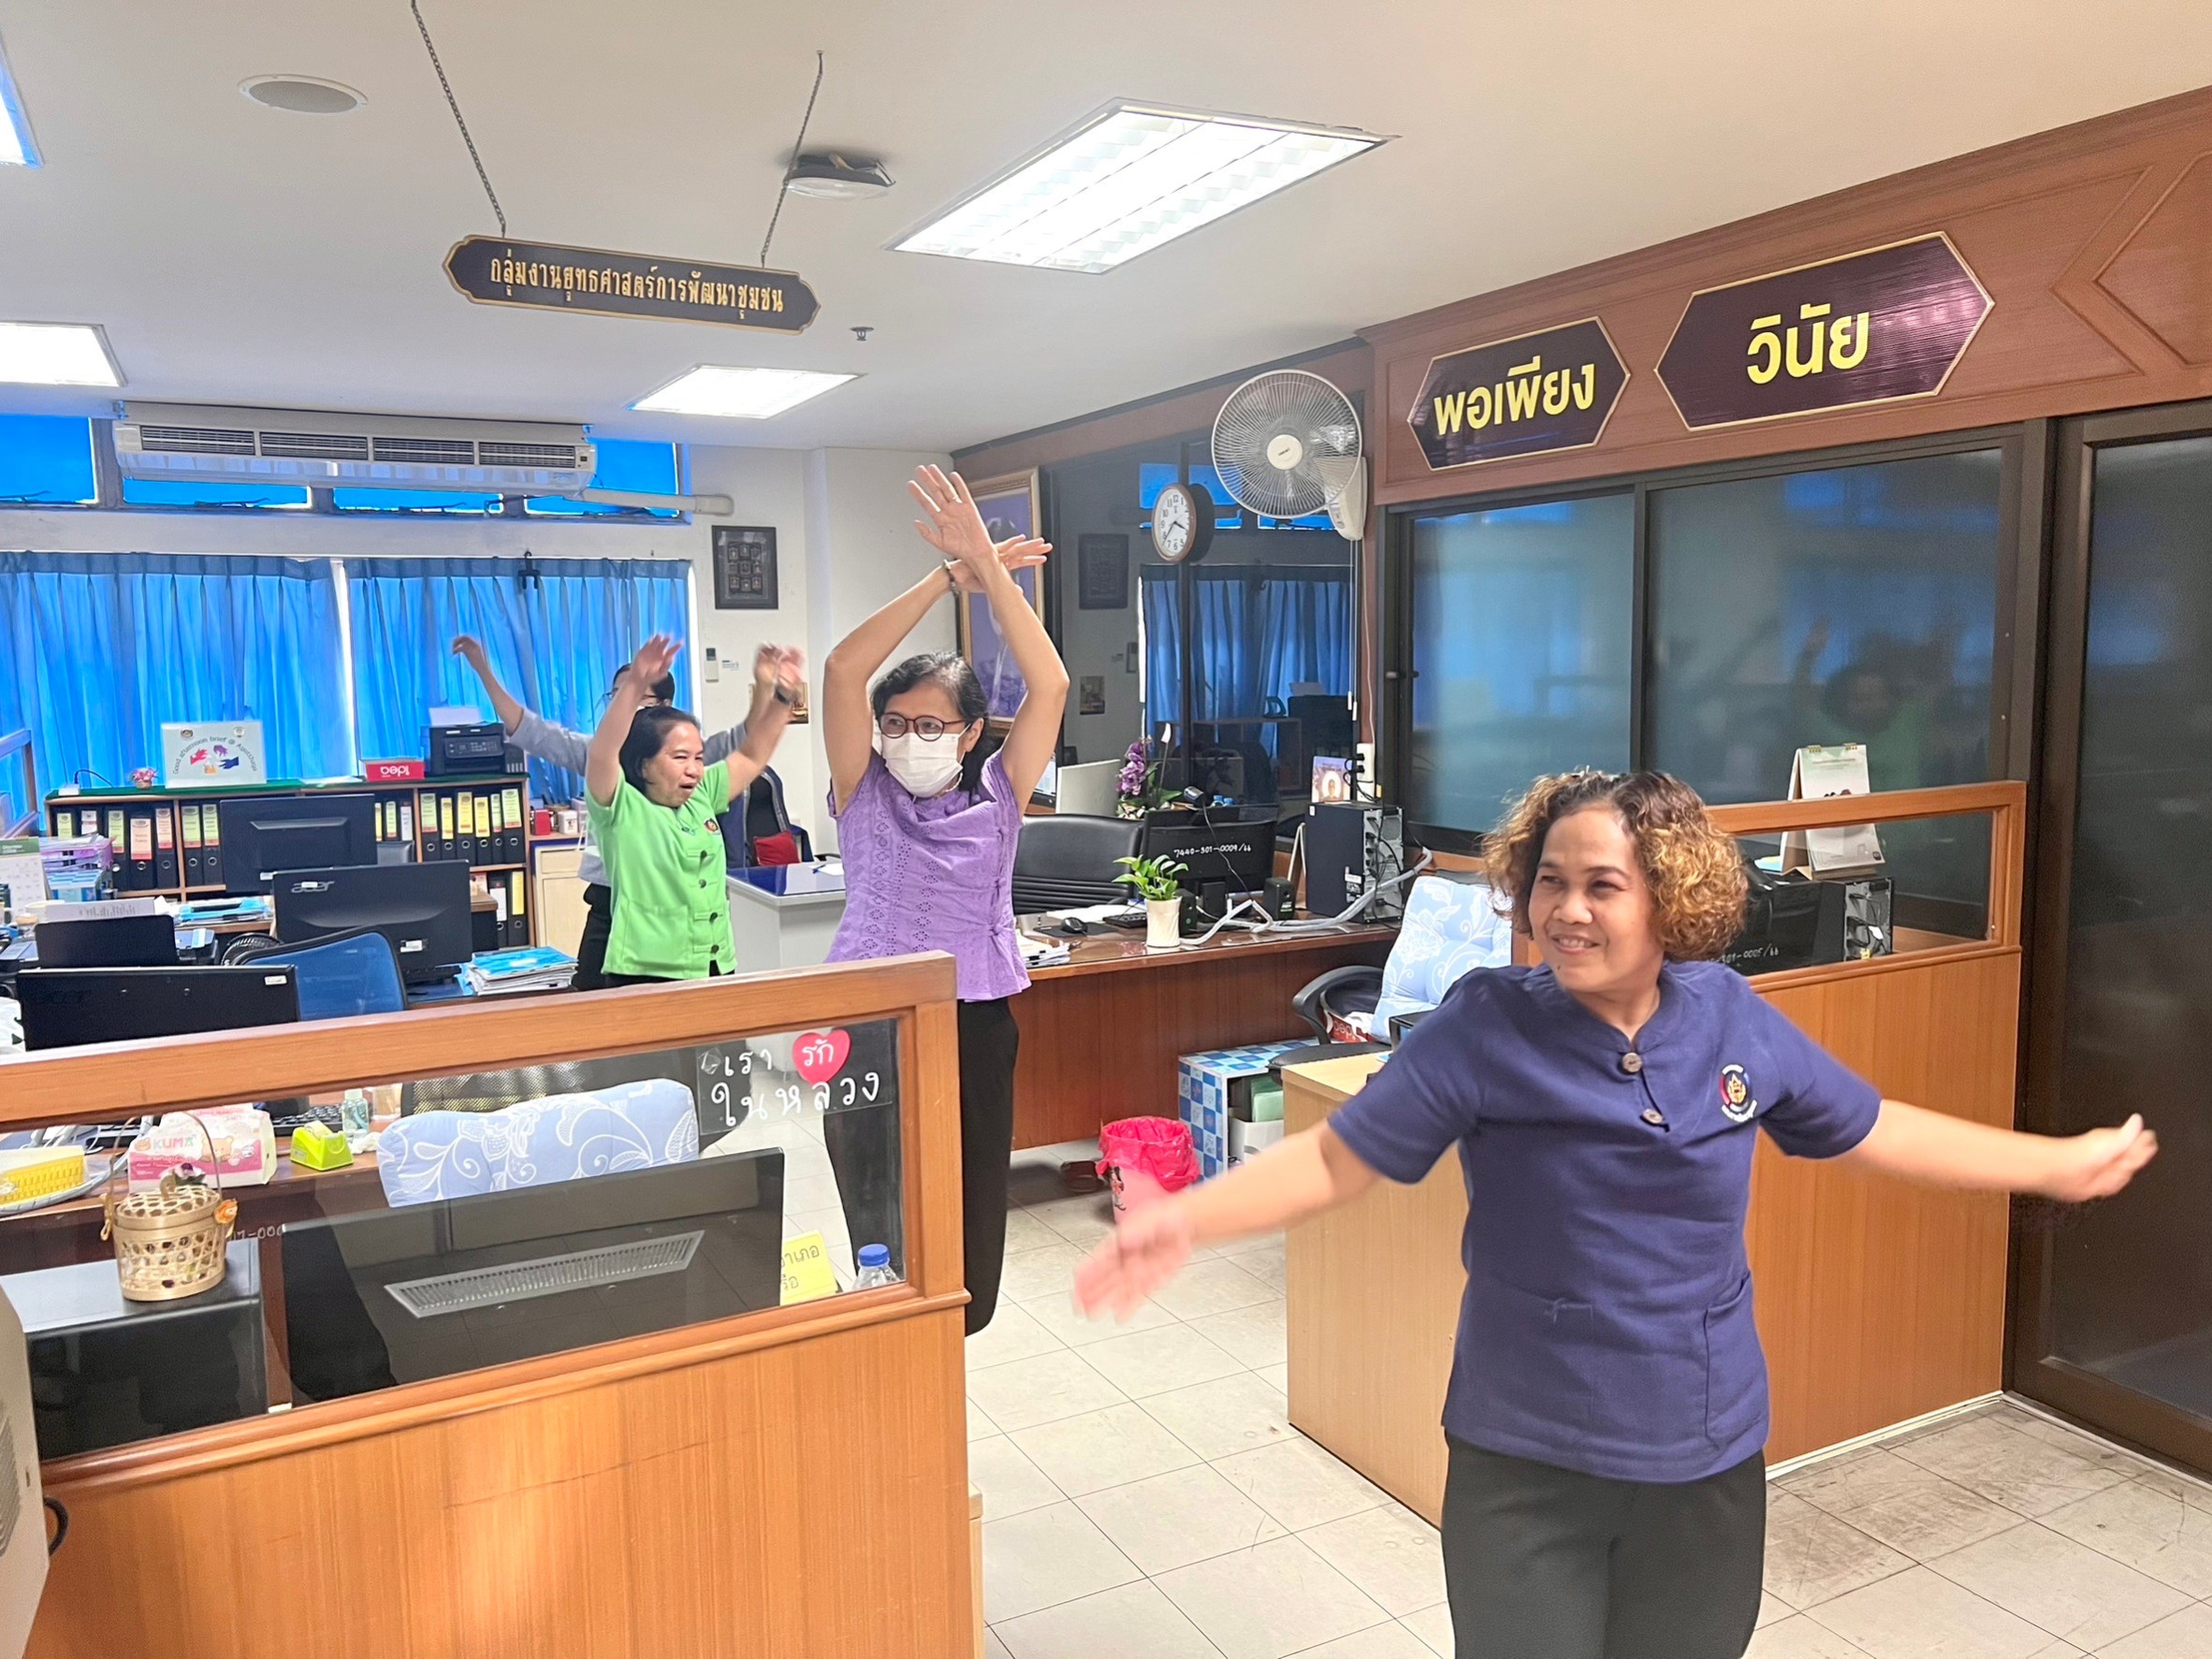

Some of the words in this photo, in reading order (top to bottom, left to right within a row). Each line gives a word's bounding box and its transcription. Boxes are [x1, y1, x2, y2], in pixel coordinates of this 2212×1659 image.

[489, 247, 784, 320] กลุ่มงานยุทธศาสตร์การพัฒนาชุมชน
[1745, 303, 1870, 385] วินัย
[1433, 356, 1595, 437] พอเพียง
[724, 1049, 772, 1077] เรา
[802, 1039, 835, 1067] รัก
[711, 1071, 880, 1127] ในหลวง
